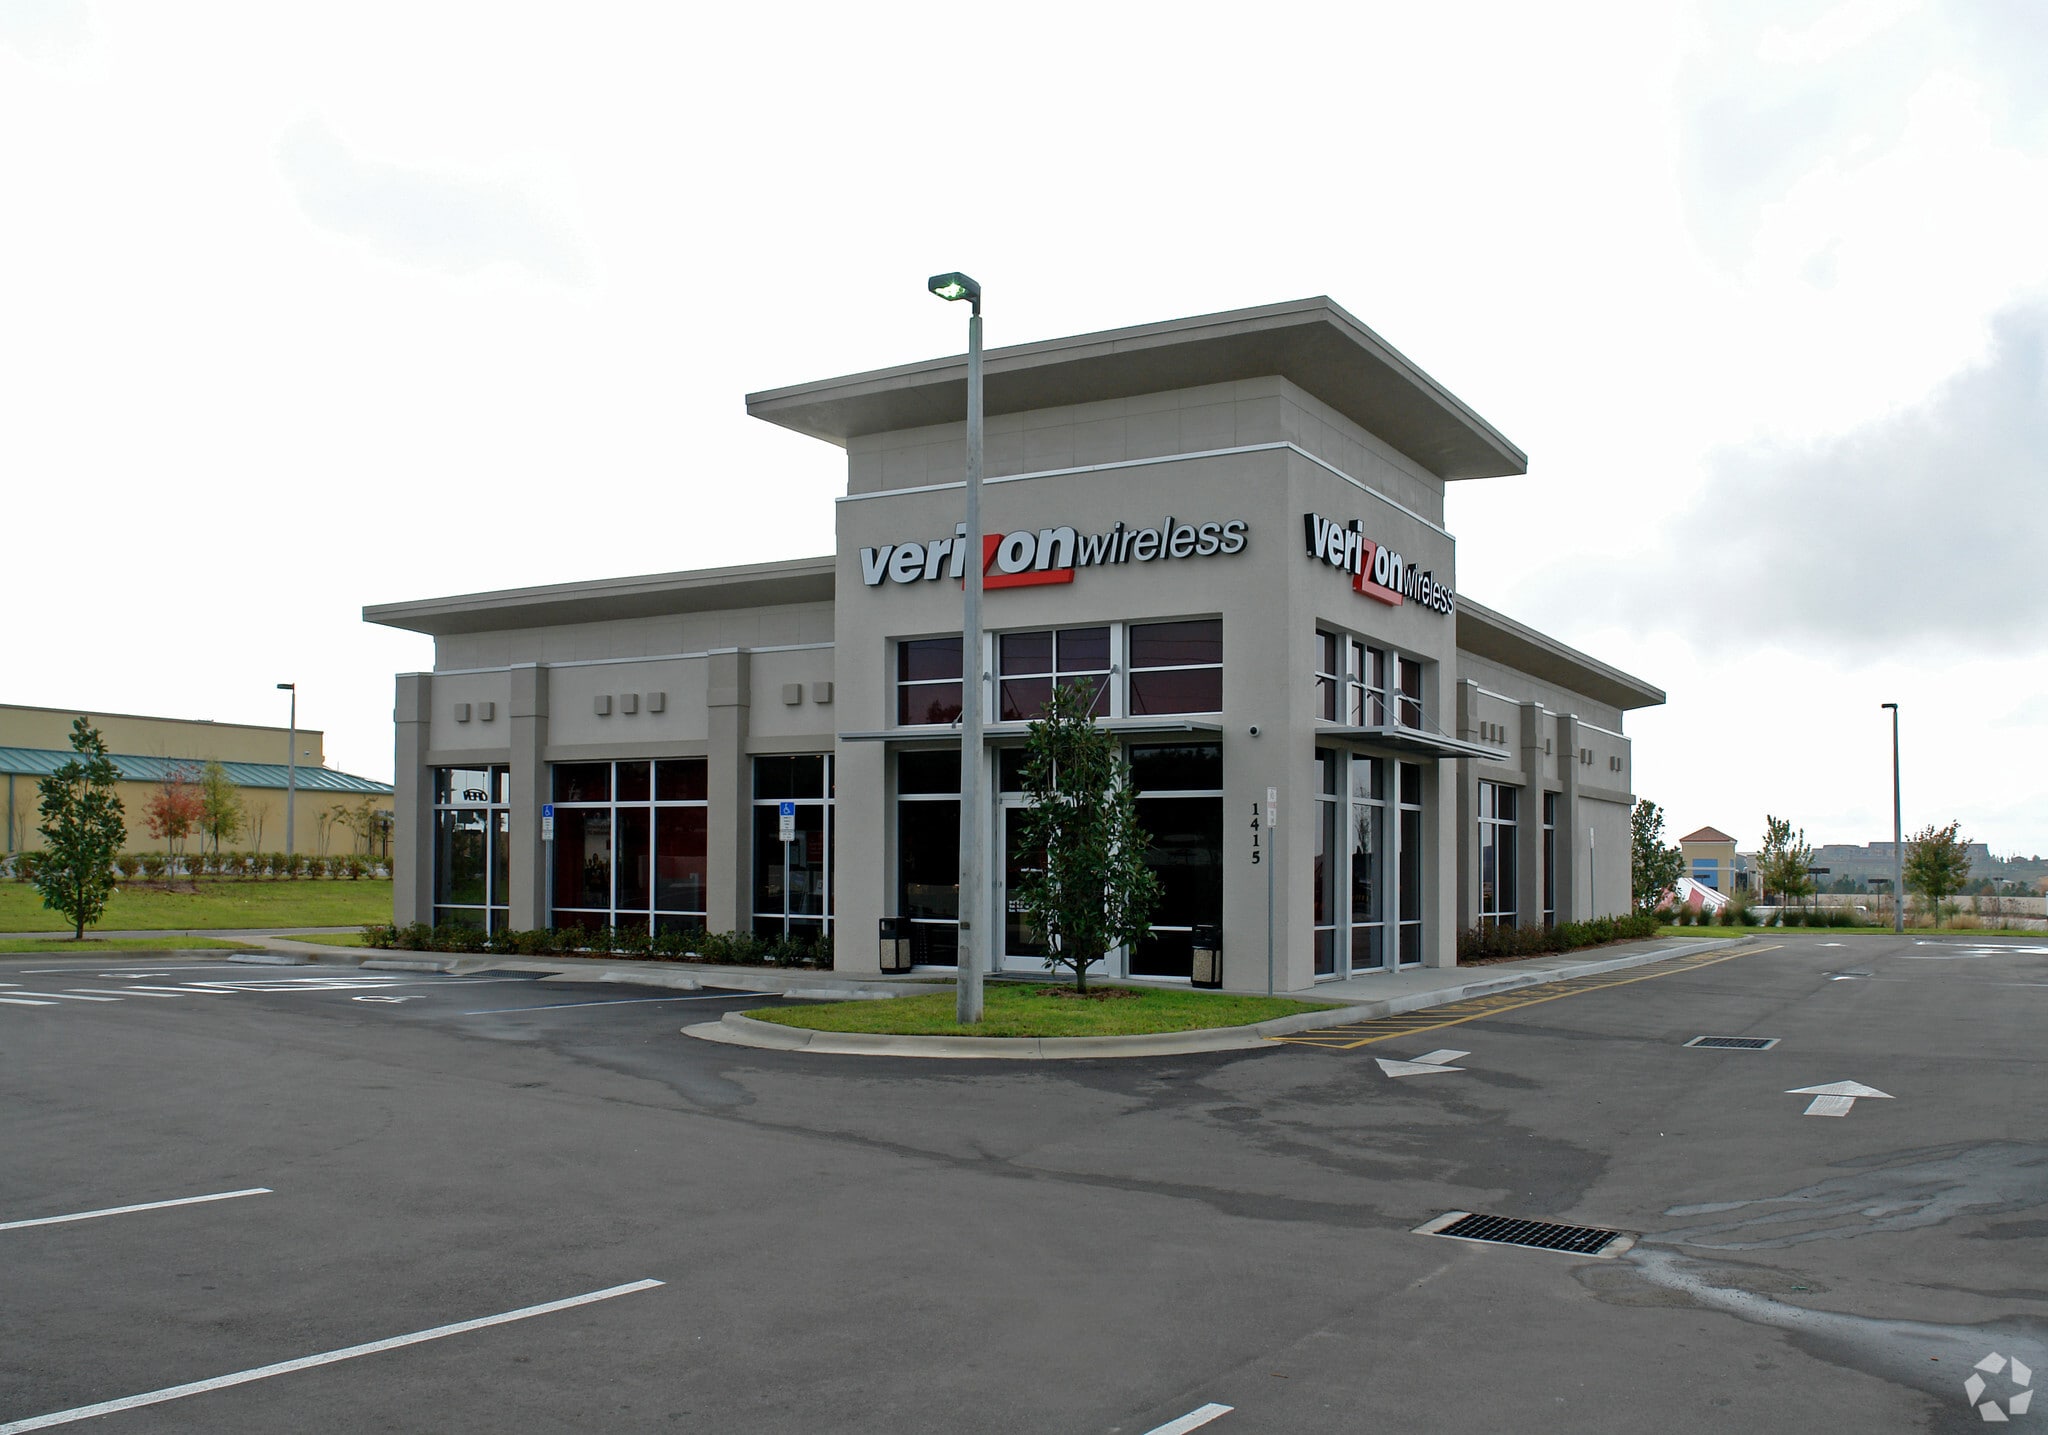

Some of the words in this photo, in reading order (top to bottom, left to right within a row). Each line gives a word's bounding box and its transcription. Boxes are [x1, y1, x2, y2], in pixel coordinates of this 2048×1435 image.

[860, 522, 1078, 591] verizon
[1077, 516, 1249, 567] wireless
[1304, 513, 1404, 606] verizon
[1403, 563, 1455, 615] wireless
[1250, 802, 1261, 865] 1415
